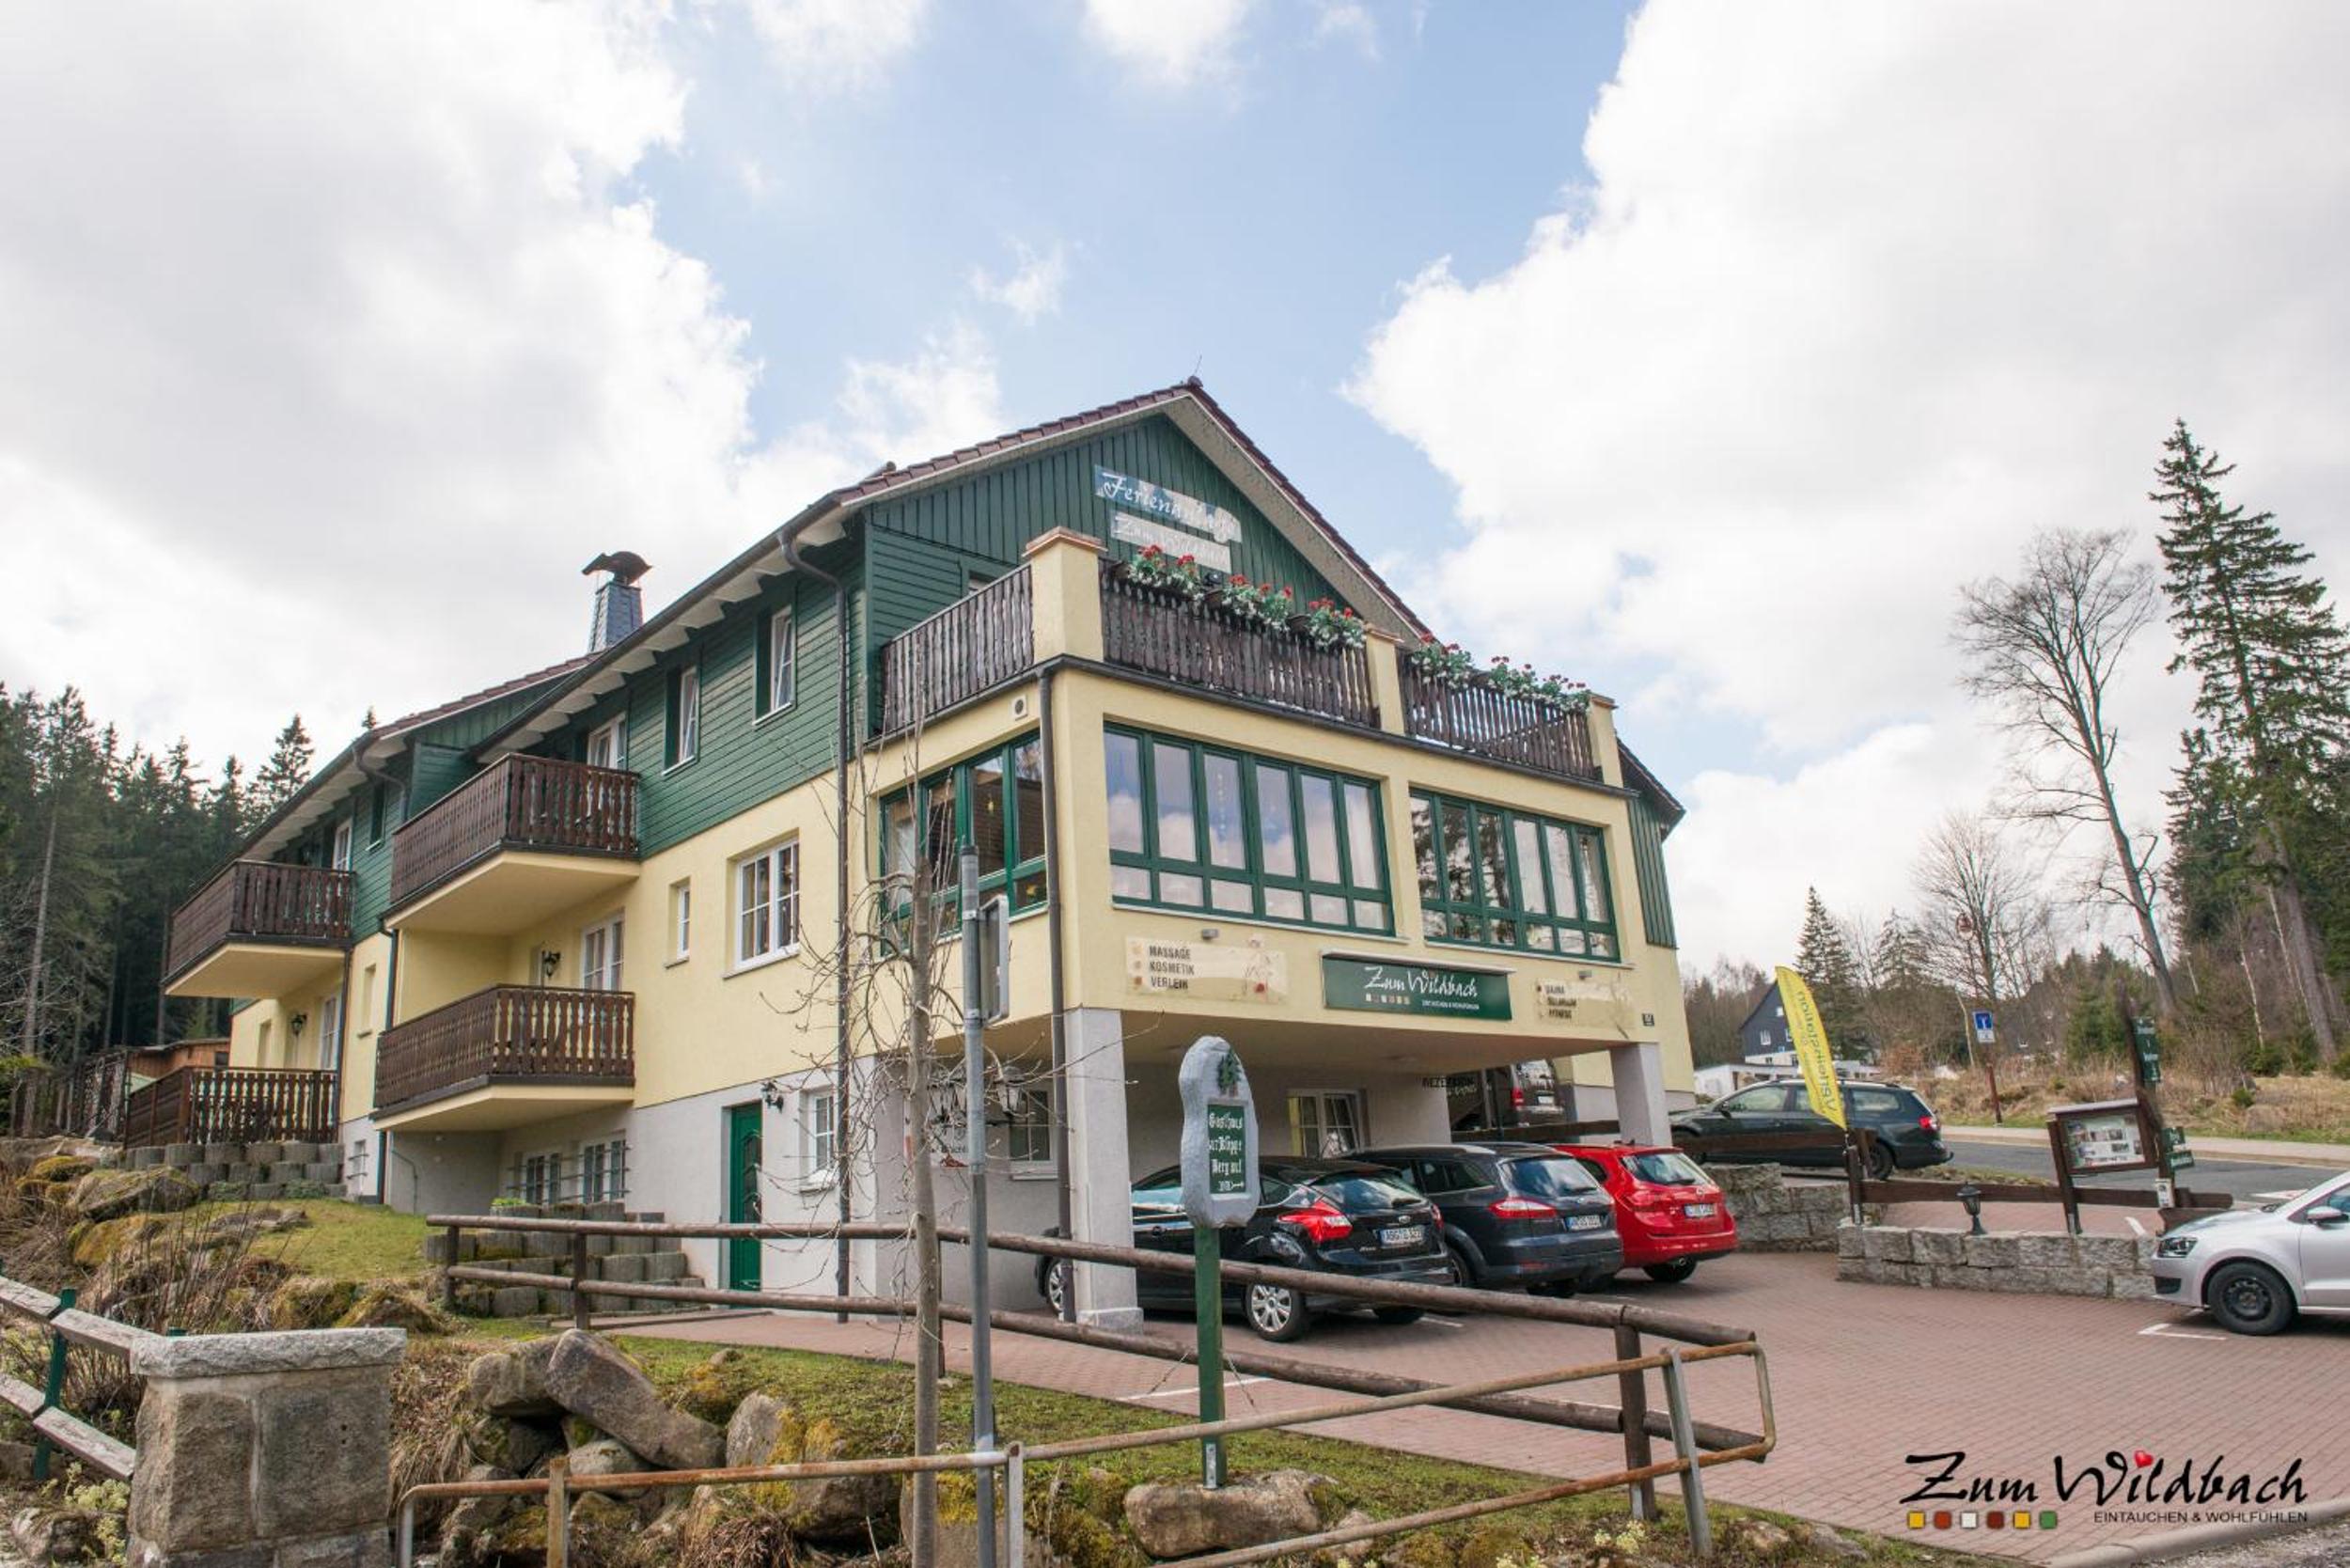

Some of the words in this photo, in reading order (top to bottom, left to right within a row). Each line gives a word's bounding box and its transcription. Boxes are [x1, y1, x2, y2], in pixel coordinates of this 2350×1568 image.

[1149, 945, 1191, 960] MASSAGE
[1149, 961, 1195, 975] KOSMETIK
[1151, 975, 1189, 990] VERLEIH
[1364, 965, 1406, 991] Zum
[1407, 969, 1479, 998] Wildbach
